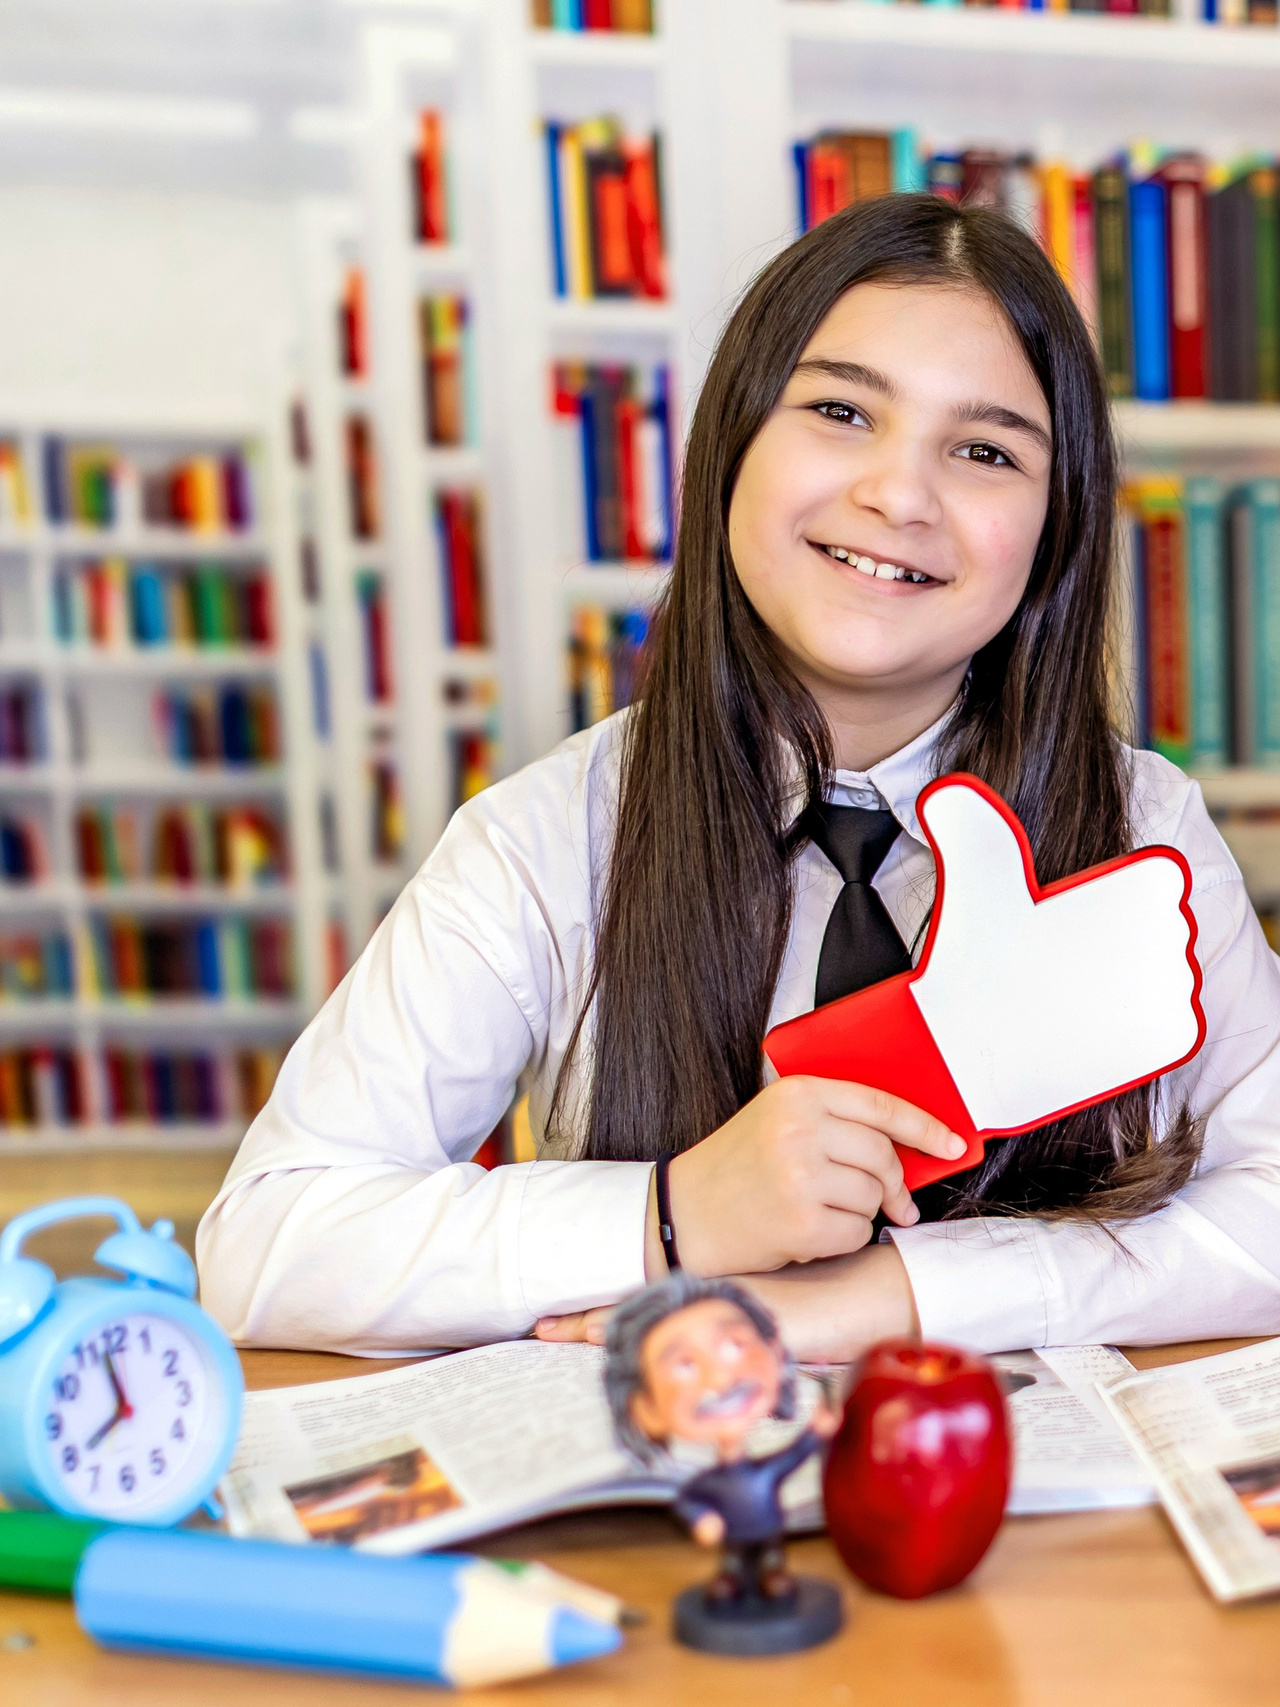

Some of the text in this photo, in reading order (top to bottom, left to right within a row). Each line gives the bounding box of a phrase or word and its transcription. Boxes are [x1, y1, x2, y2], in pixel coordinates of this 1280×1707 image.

[101, 1325, 128, 1354] 12
[139, 1328, 151, 1354] 1
[72, 1342, 100, 1369] 11
[163, 1349, 179, 1377] 2
[54, 1373, 80, 1400] 10
[176, 1380, 192, 1406] 3
[46, 1412, 63, 1441] 9
[171, 1417, 185, 1441] 4
[62, 1444, 79, 1472] 8
[151, 1448, 166, 1475] 5
[88, 1464, 101, 1493] 7
[119, 1464, 136, 1492] 6
